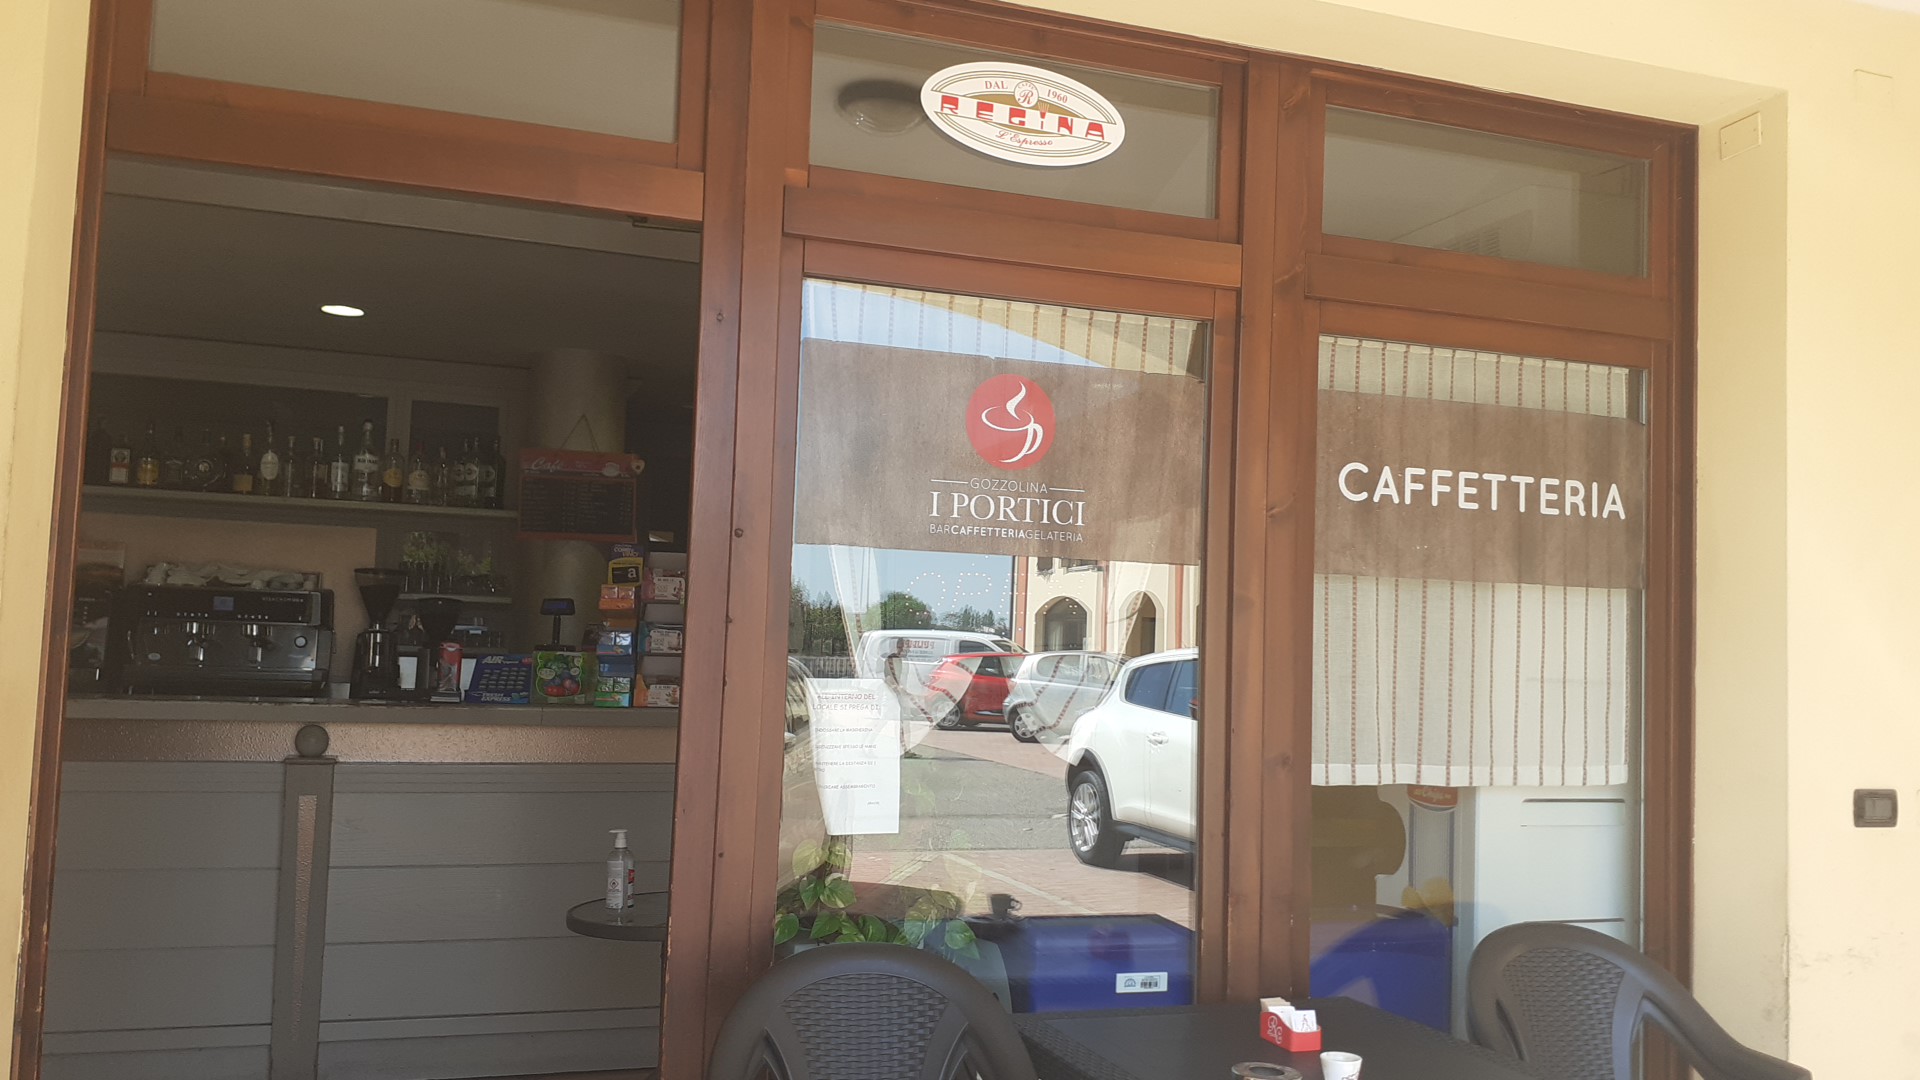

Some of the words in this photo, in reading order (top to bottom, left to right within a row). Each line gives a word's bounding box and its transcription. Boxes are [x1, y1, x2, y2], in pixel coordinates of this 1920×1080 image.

[985, 80, 1008, 90] DAL
[1047, 89, 1068, 104] 1960
[995, 129, 1053, 148] L'Espresso
[970, 477, 1048, 494] GOZZOLINA
[1338, 461, 1626, 520] CAFFETTERIA
[929, 491, 941, 517] I
[950, 492, 1086, 526] PORTICI
